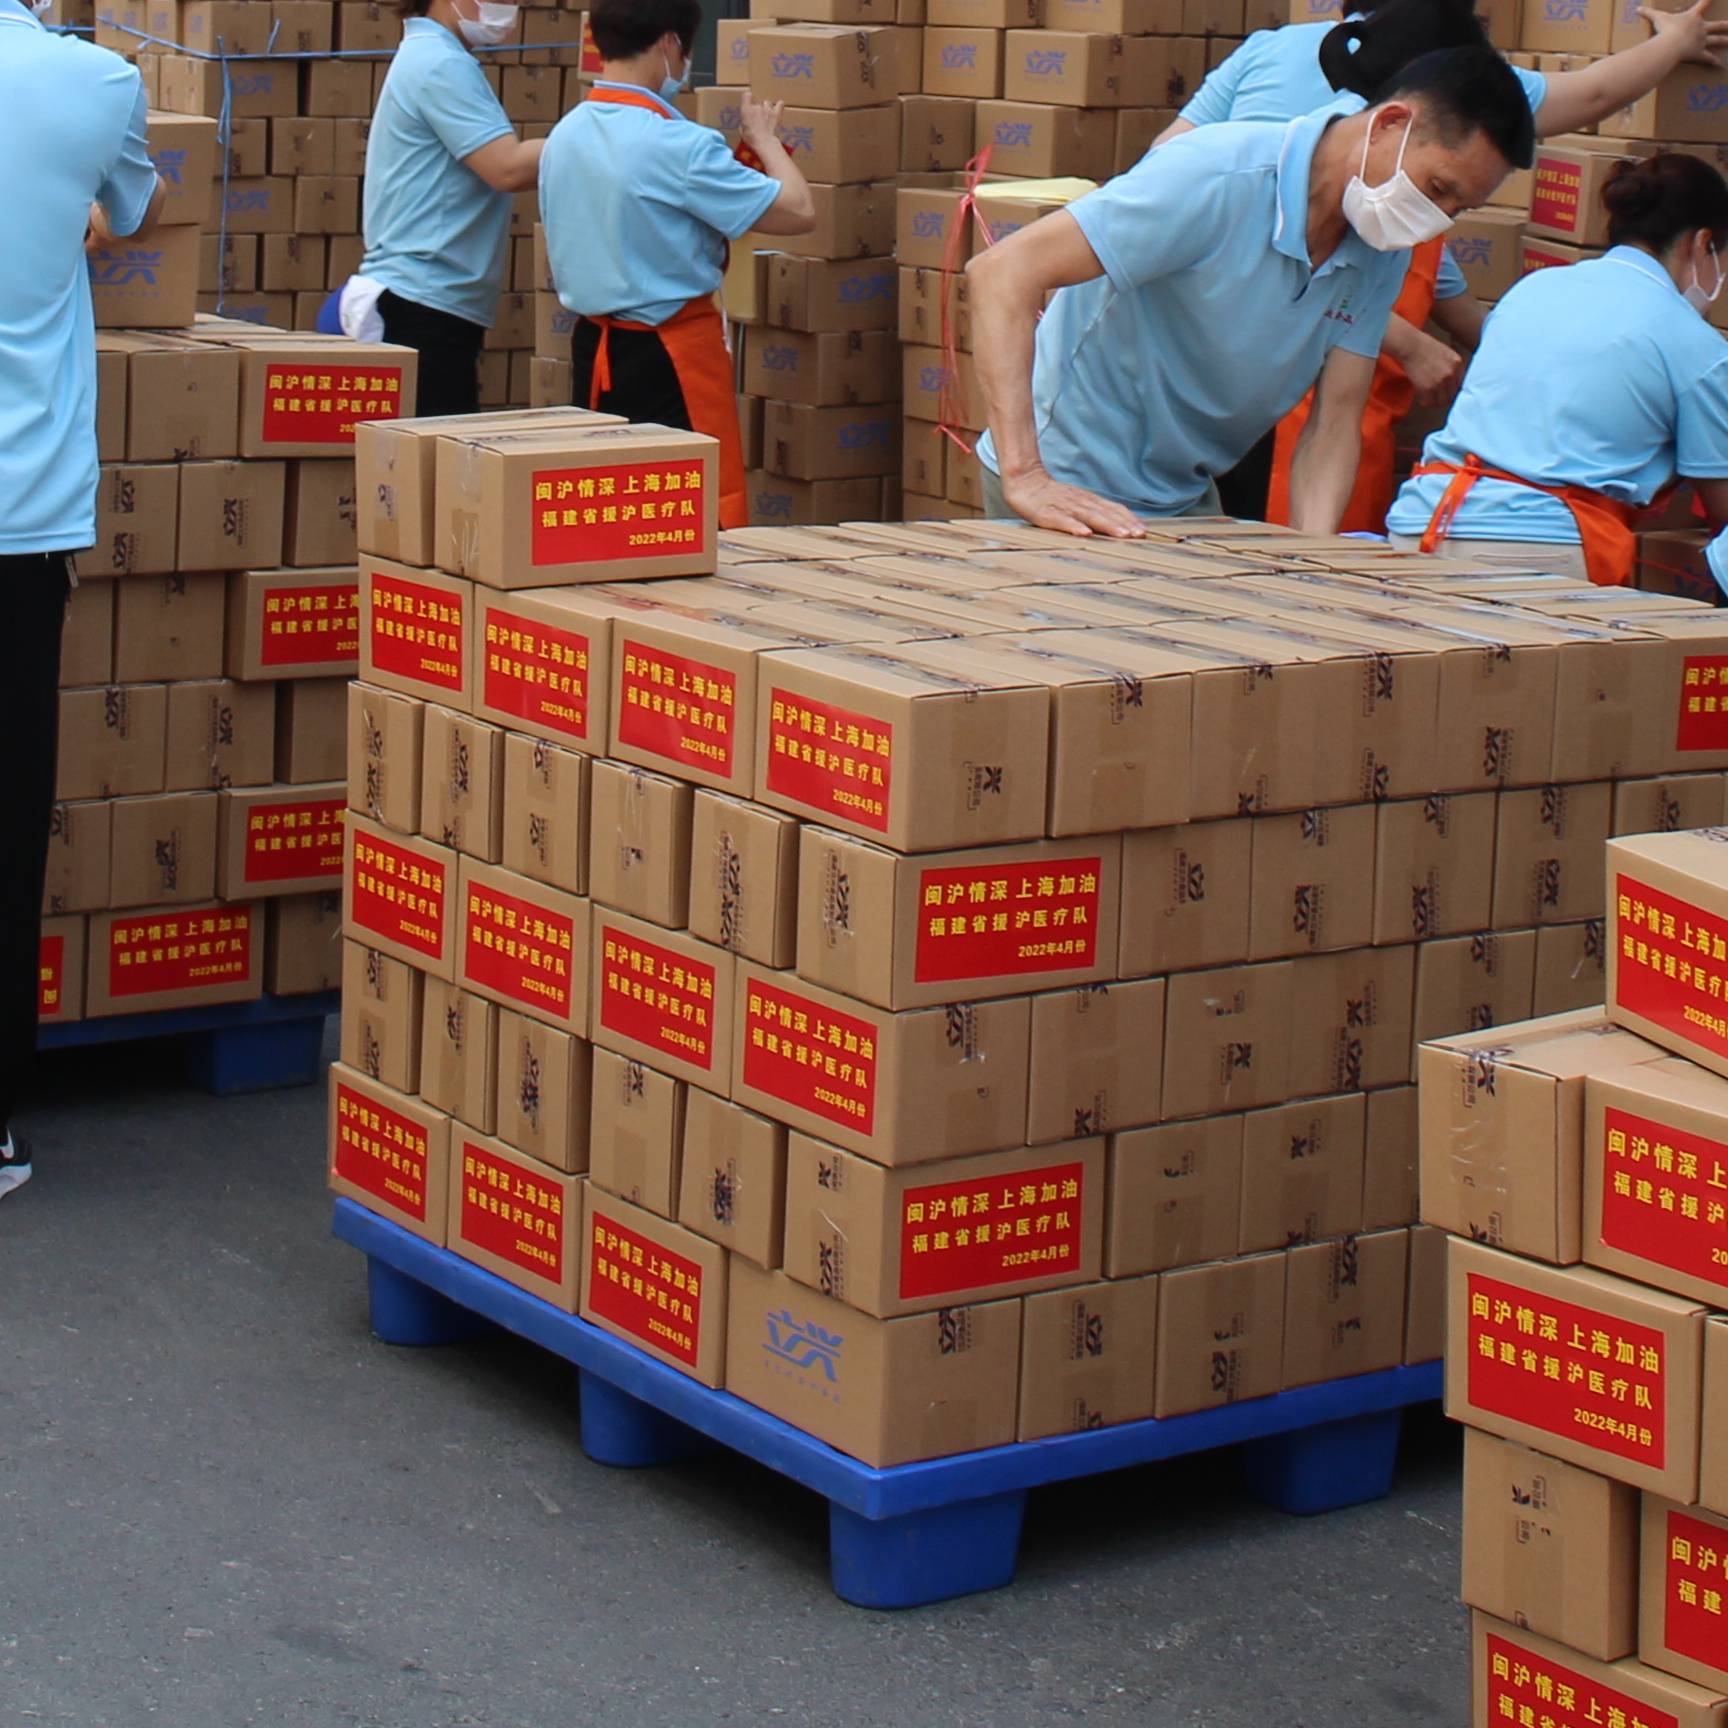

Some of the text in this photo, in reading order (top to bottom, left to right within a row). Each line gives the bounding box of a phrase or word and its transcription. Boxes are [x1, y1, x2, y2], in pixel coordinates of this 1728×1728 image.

[542, 499, 695, 527] 福建省援沪医疗队
[628, 528, 695, 545] 2022年4月份
[929, 905, 1087, 936] 福建省援沪医疗队
[1017, 939, 1086, 957] 2022年4月份
[912, 1210, 1070, 1253] 福建省援沪医疗队
[1001, 1243, 1069, 1266] 2022年4月份
[1478, 1333, 1652, 1409] 福建省援沪医疗队
[1573, 1407, 1652, 1446] 2022年4月份
